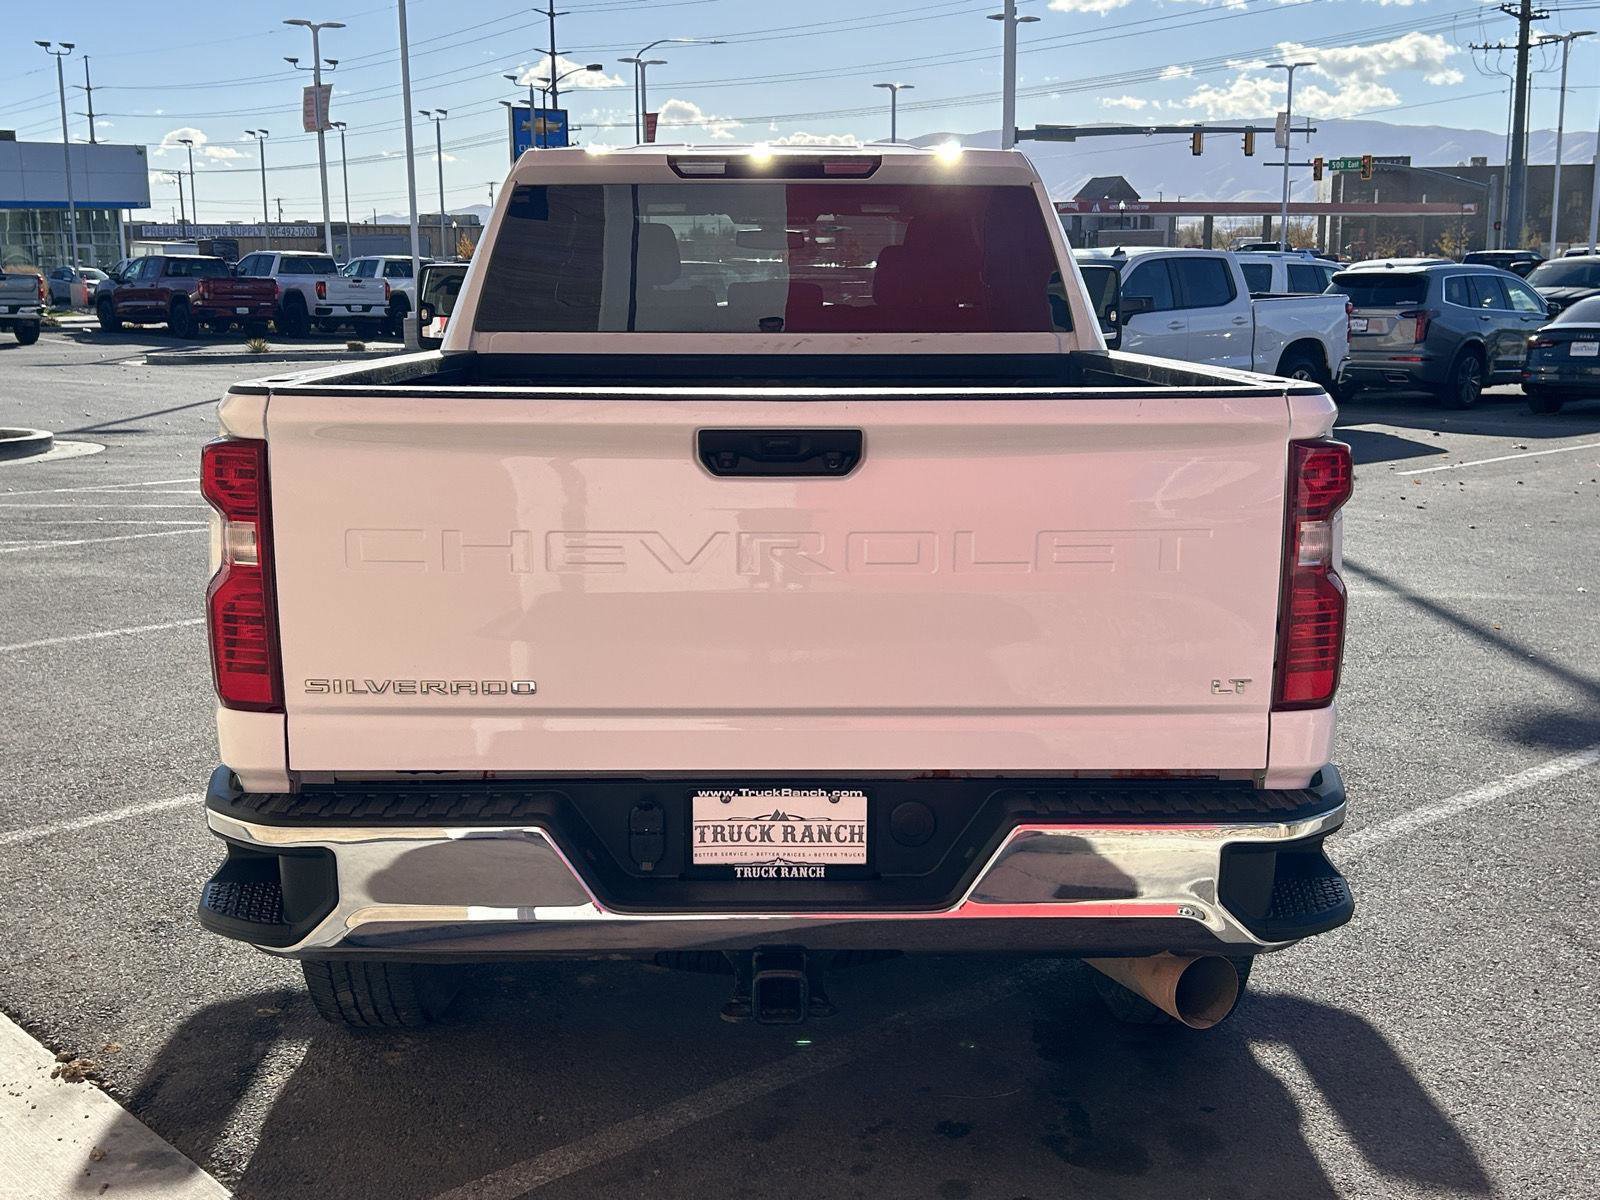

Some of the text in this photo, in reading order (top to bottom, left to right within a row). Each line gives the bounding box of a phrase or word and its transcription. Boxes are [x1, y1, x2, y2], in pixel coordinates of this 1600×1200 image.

[1331, 160, 1359, 169] 500 East
[230, 226, 263, 237] SUPPLY
[344, 528, 1214, 575] CHEVROLET
[304, 678, 538, 696] SILVERADO
[1210, 678, 1253, 695] LT
[697, 788, 863, 797] www.TruckRanch.com
[694, 824, 865, 844] TRUCK RANCH
[734, 866, 826, 878] TRUCK RANCH
